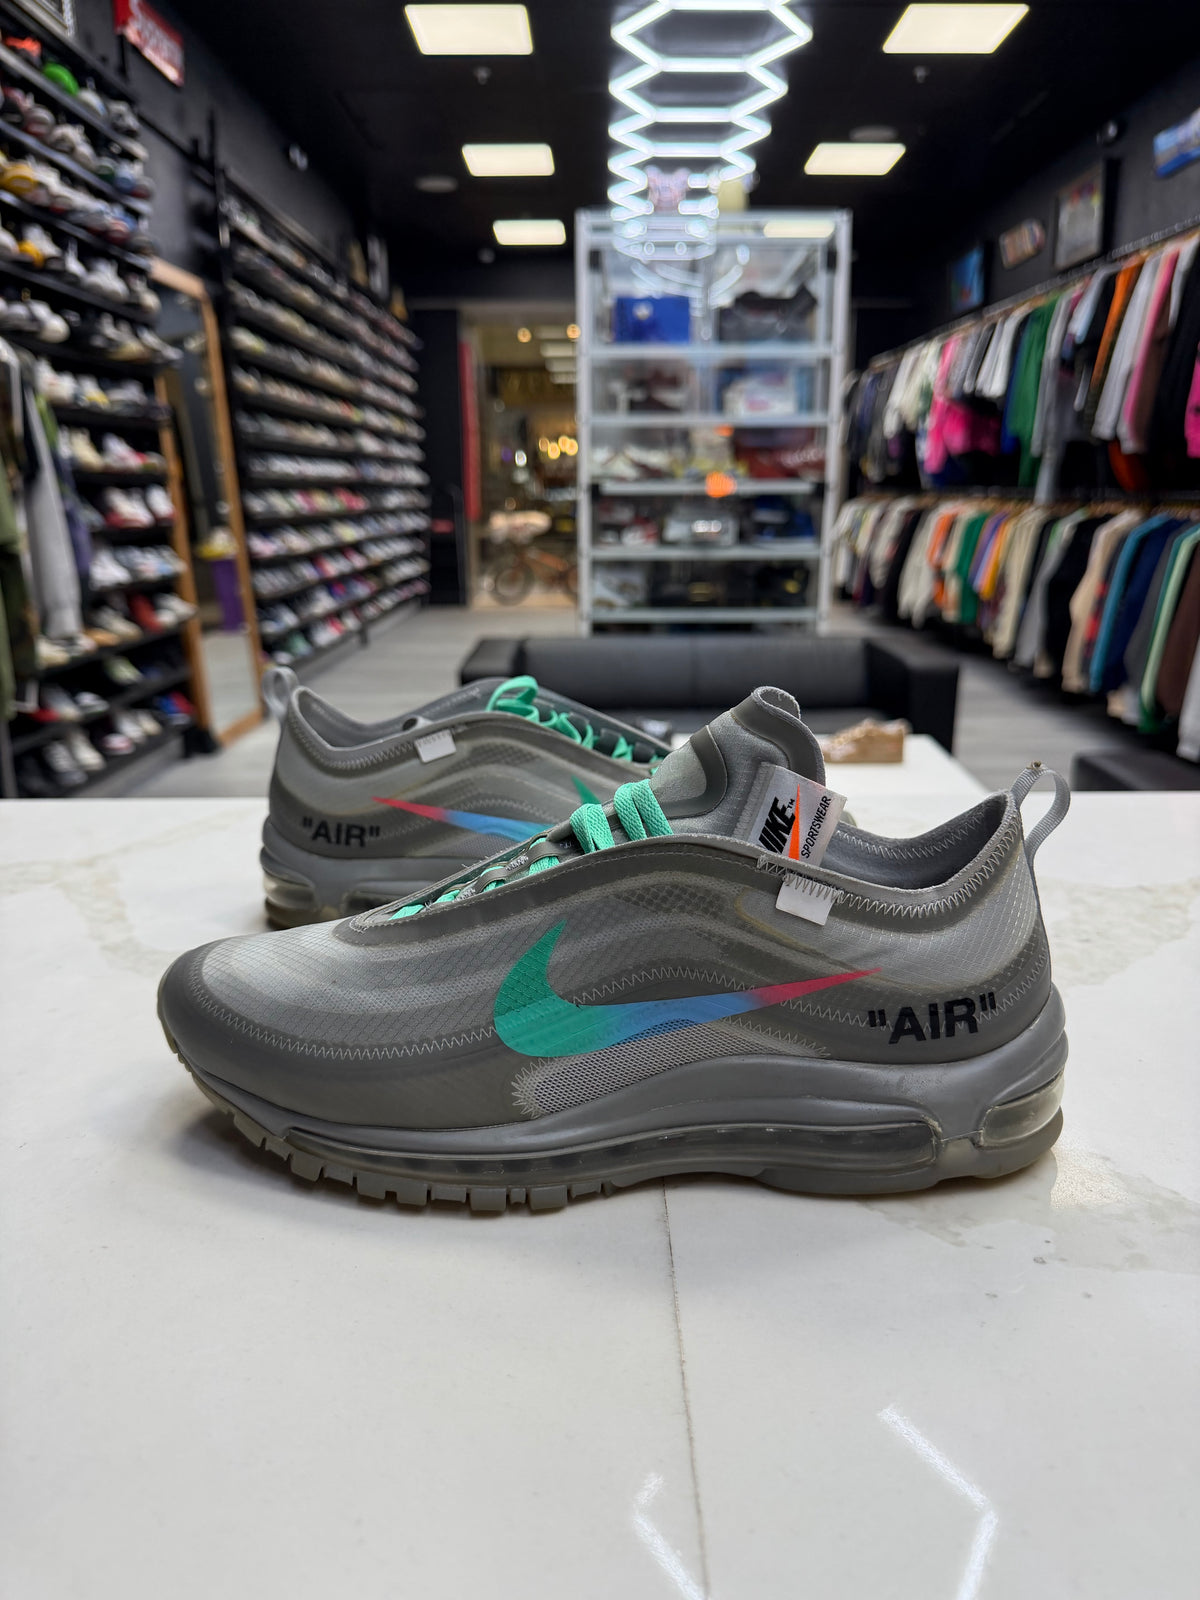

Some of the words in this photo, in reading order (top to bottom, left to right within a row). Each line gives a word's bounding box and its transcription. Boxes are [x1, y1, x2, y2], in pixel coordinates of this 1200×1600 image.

[302, 816, 380, 847] "AIR"
[800, 795, 832, 859] SPORTSWEAR
[867, 991, 997, 1045] "AIR"
